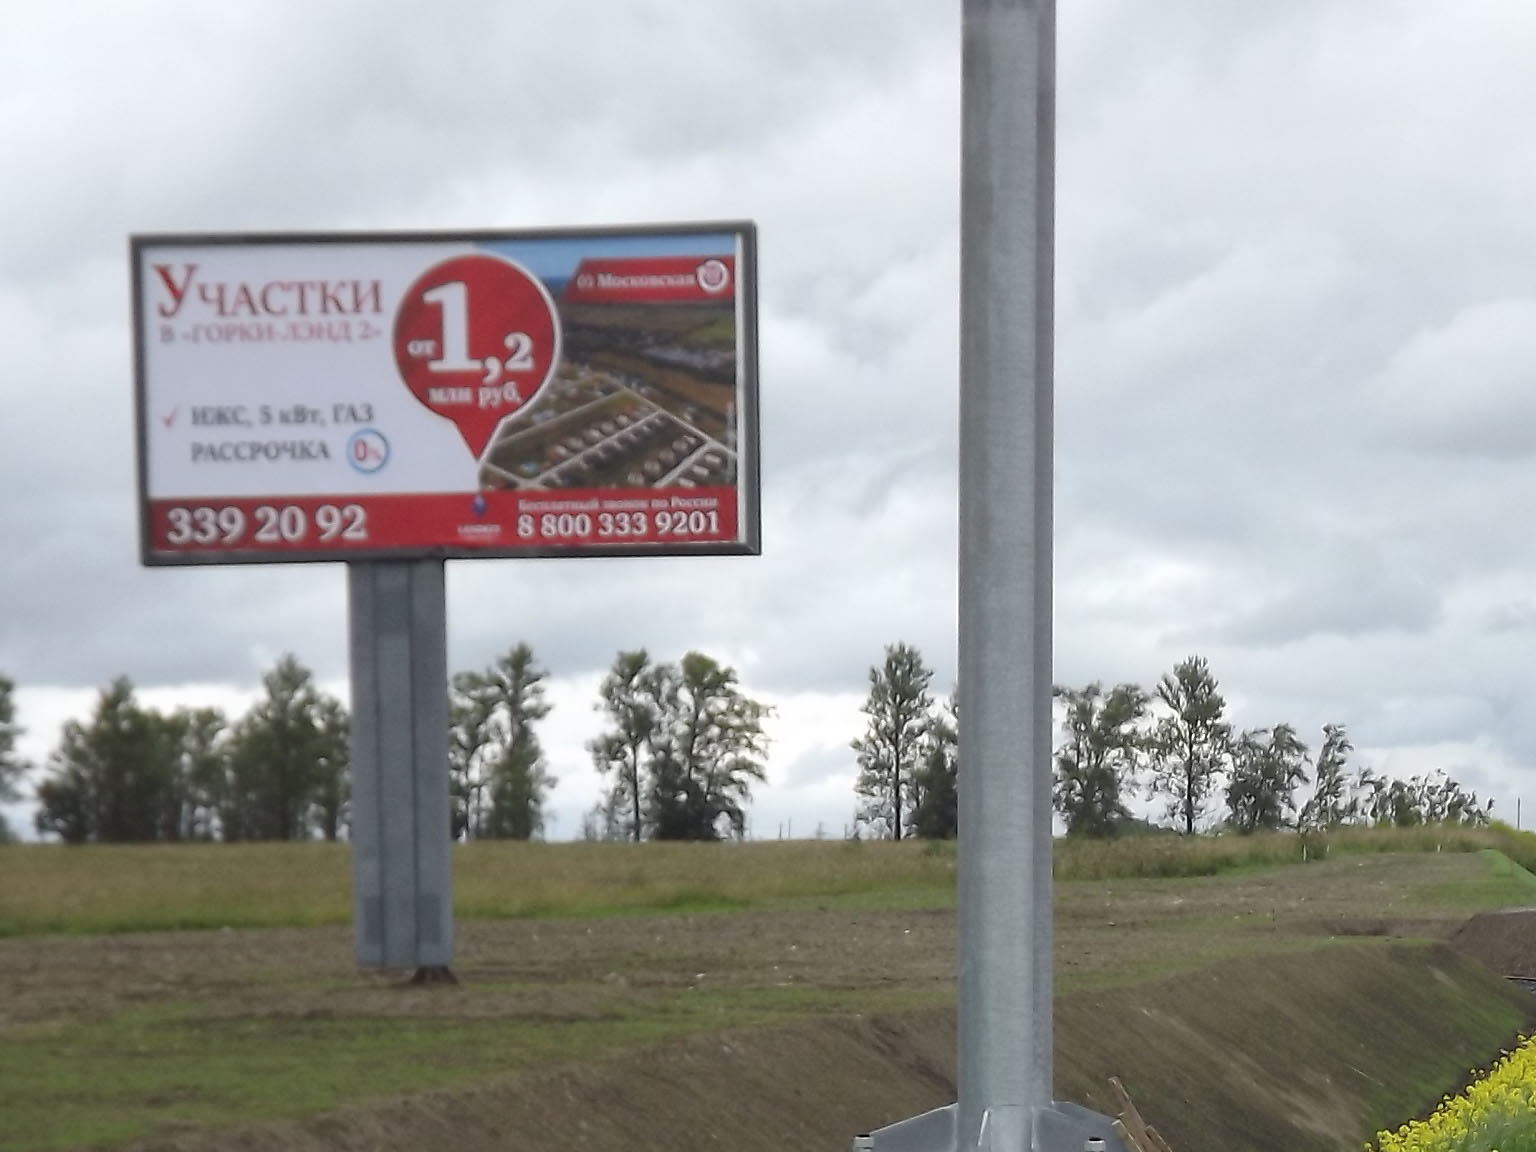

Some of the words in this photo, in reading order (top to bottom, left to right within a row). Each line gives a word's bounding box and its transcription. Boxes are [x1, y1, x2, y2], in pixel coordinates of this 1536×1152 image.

[407, 339, 436, 357] от
[422, 281, 534, 384] 1,2
[429, 387, 472, 404] млн
[478, 381, 521, 408] руб.
[259, 405, 272, 424] 5
[333, 403, 374, 422] ГАЗ
[191, 441, 329, 462] РАССРОЧКА
[167, 507, 245, 545] 339
[254, 506, 307, 542] 20
[316, 504, 368, 542] 92
[517, 513, 534, 537] 8
[541, 513, 591, 537] 800
[598, 512, 647, 536] 333
[655, 510, 719, 535] 9201
